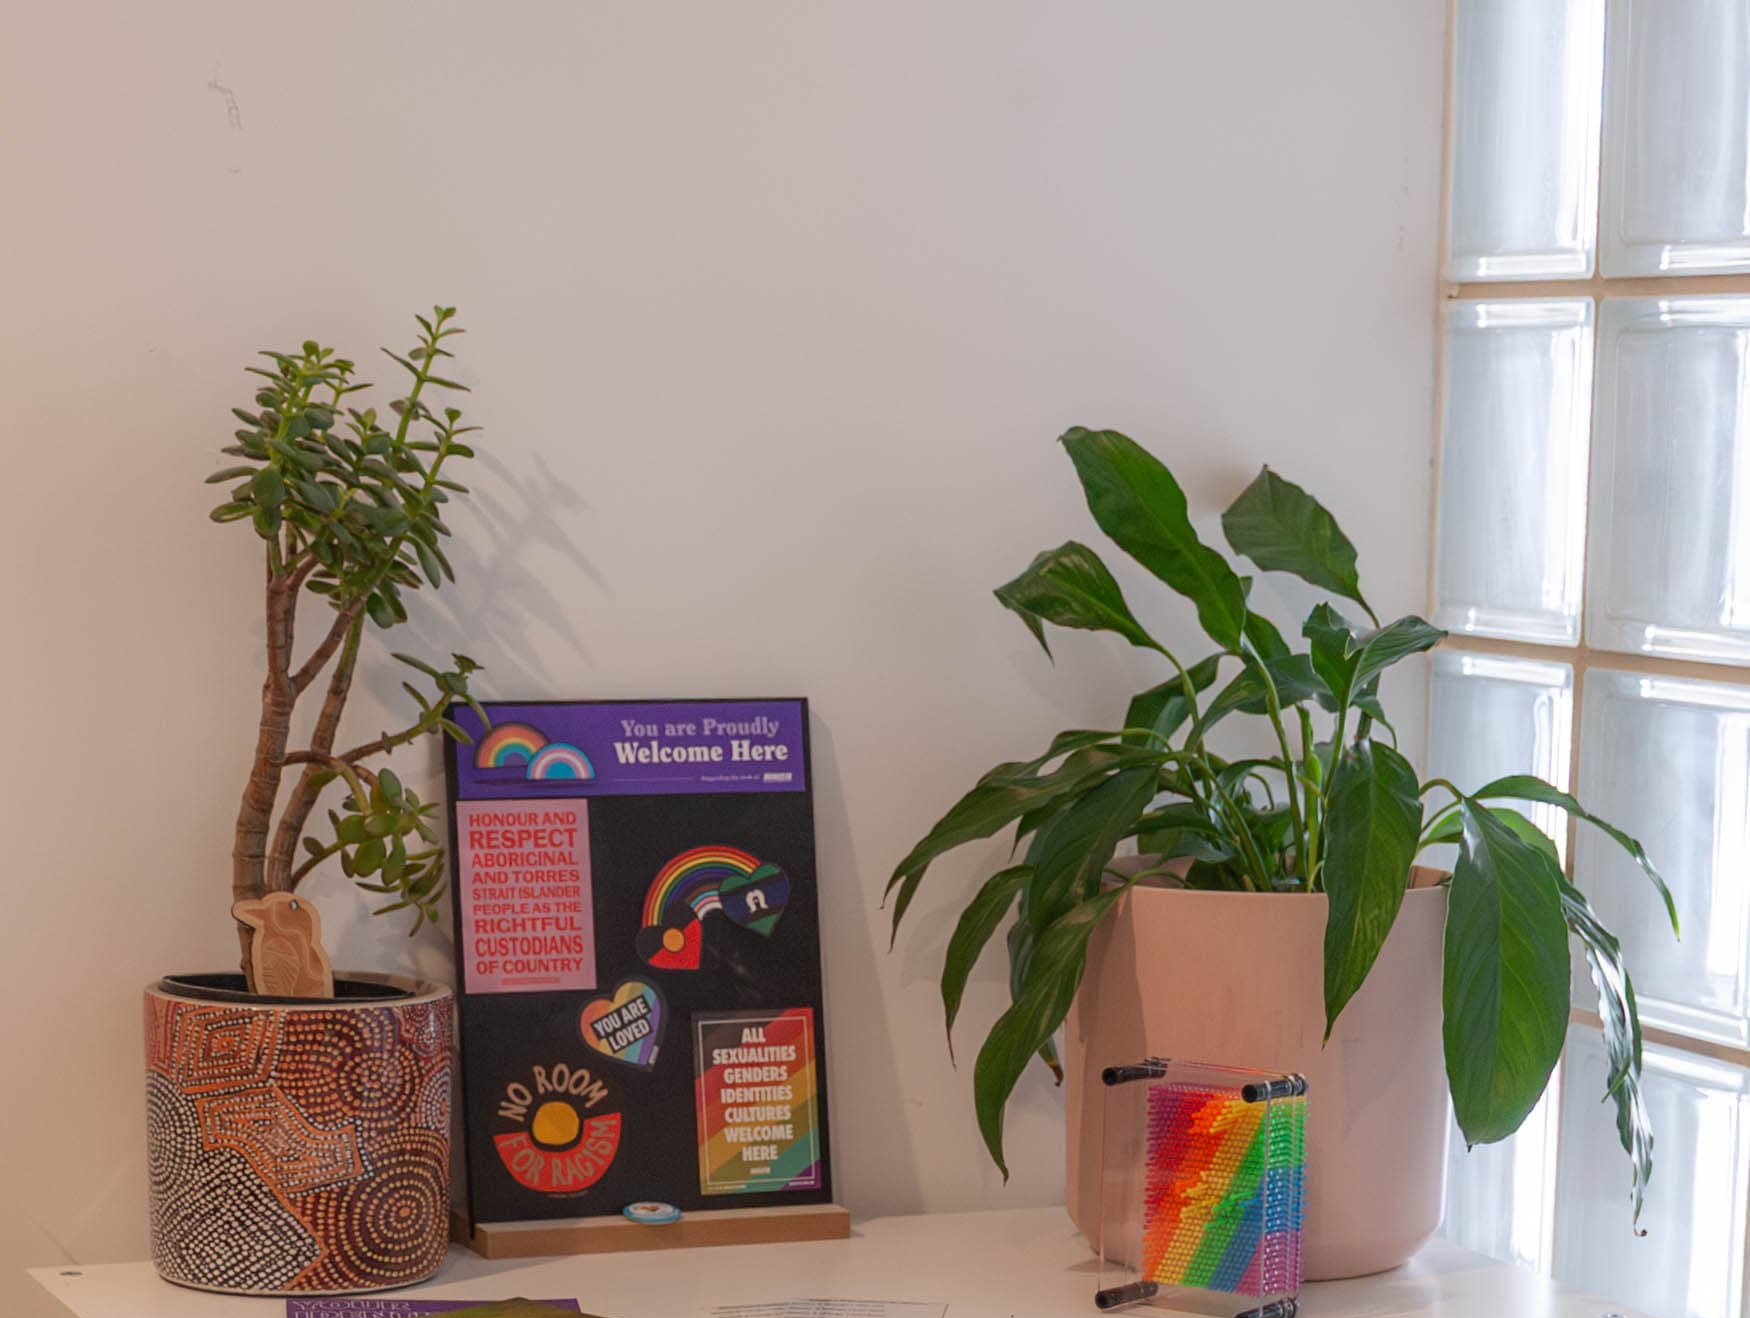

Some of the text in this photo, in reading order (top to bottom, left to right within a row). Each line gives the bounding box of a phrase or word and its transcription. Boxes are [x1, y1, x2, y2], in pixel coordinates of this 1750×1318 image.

[621, 716, 780, 739] You are Proudly
[613, 740, 788, 764] Welcome Here
[468, 812, 577, 828] HONOUR AND
[468, 828, 578, 849] RESPECT
[472, 851, 579, 869] ABORIGINAL
[472, 870, 580, 885] AND TORRES
[472, 886, 581, 900] STRAIT ISLANDER
[473, 901, 582, 916] PEOPLE AS THE
[474, 917, 582, 934] RIGHTFUL
[475, 935, 584, 957] CUSTODIANS
[476, 958, 583, 975] OF COUNTRY
[593, 996, 649, 1037] YOU ARE
[608, 1019, 651, 1052] LOVED
[741, 1027, 766, 1043] ALL
[712, 1045, 797, 1065] SEXUALITIES
[723, 1066, 788, 1084] GENDERS
[498, 1063, 608, 1122] NO ROOM
[720, 1086, 793, 1104] IDENTITIES
[724, 1105, 792, 1124] CULTURES
[723, 1125, 794, 1143] WELCOME
[500, 1117, 619, 1187] FOR RACISM
[741, 1145, 778, 1162] HERE
